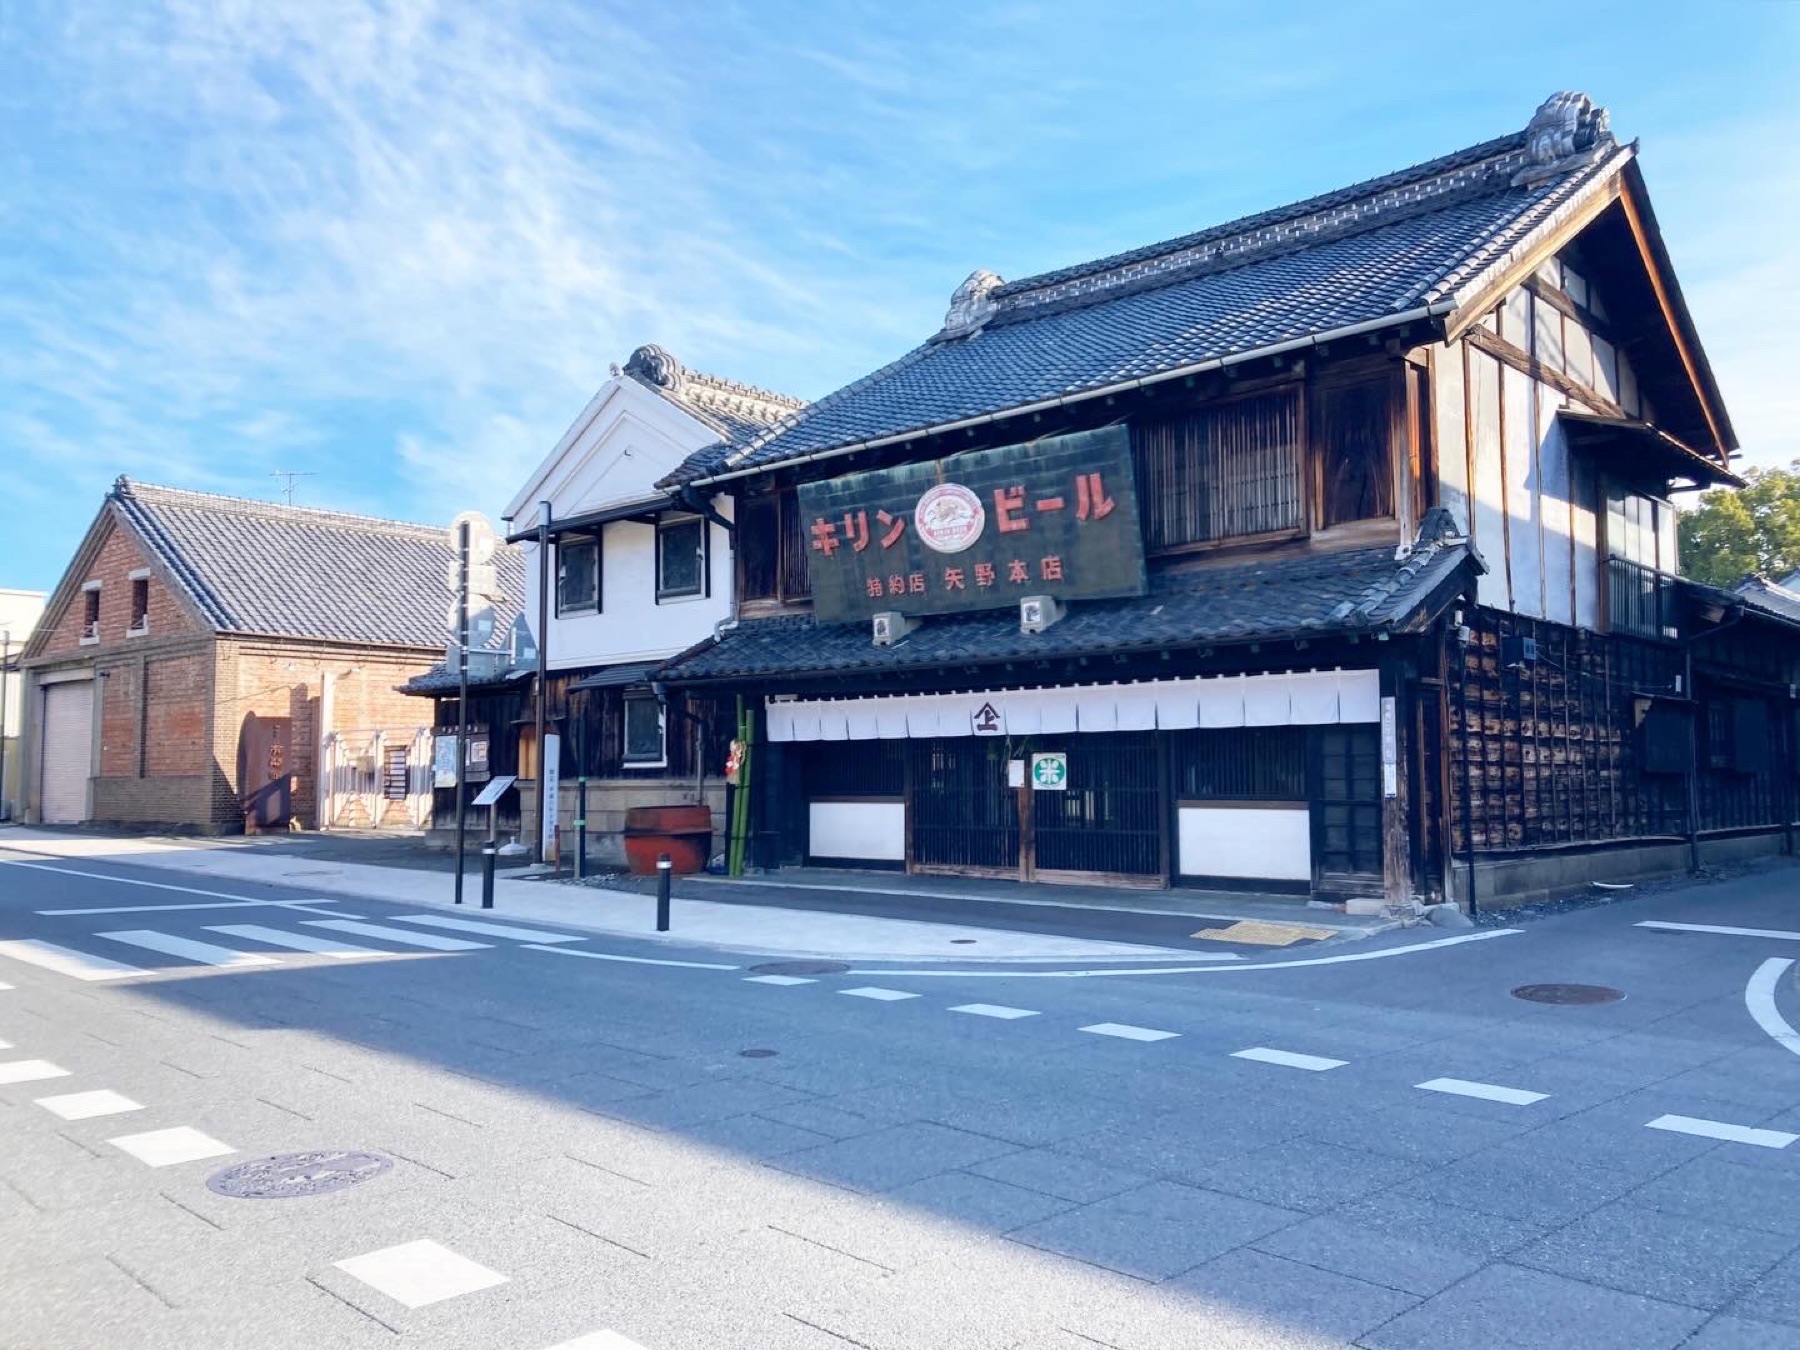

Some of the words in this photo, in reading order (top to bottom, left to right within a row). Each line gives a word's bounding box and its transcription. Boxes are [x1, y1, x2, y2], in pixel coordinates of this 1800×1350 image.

[810, 510, 906, 557] キリン
[993, 472, 1116, 534] ビール
[866, 573, 925, 598] 特約店
[944, 555, 1063, 591] 矢野本店
